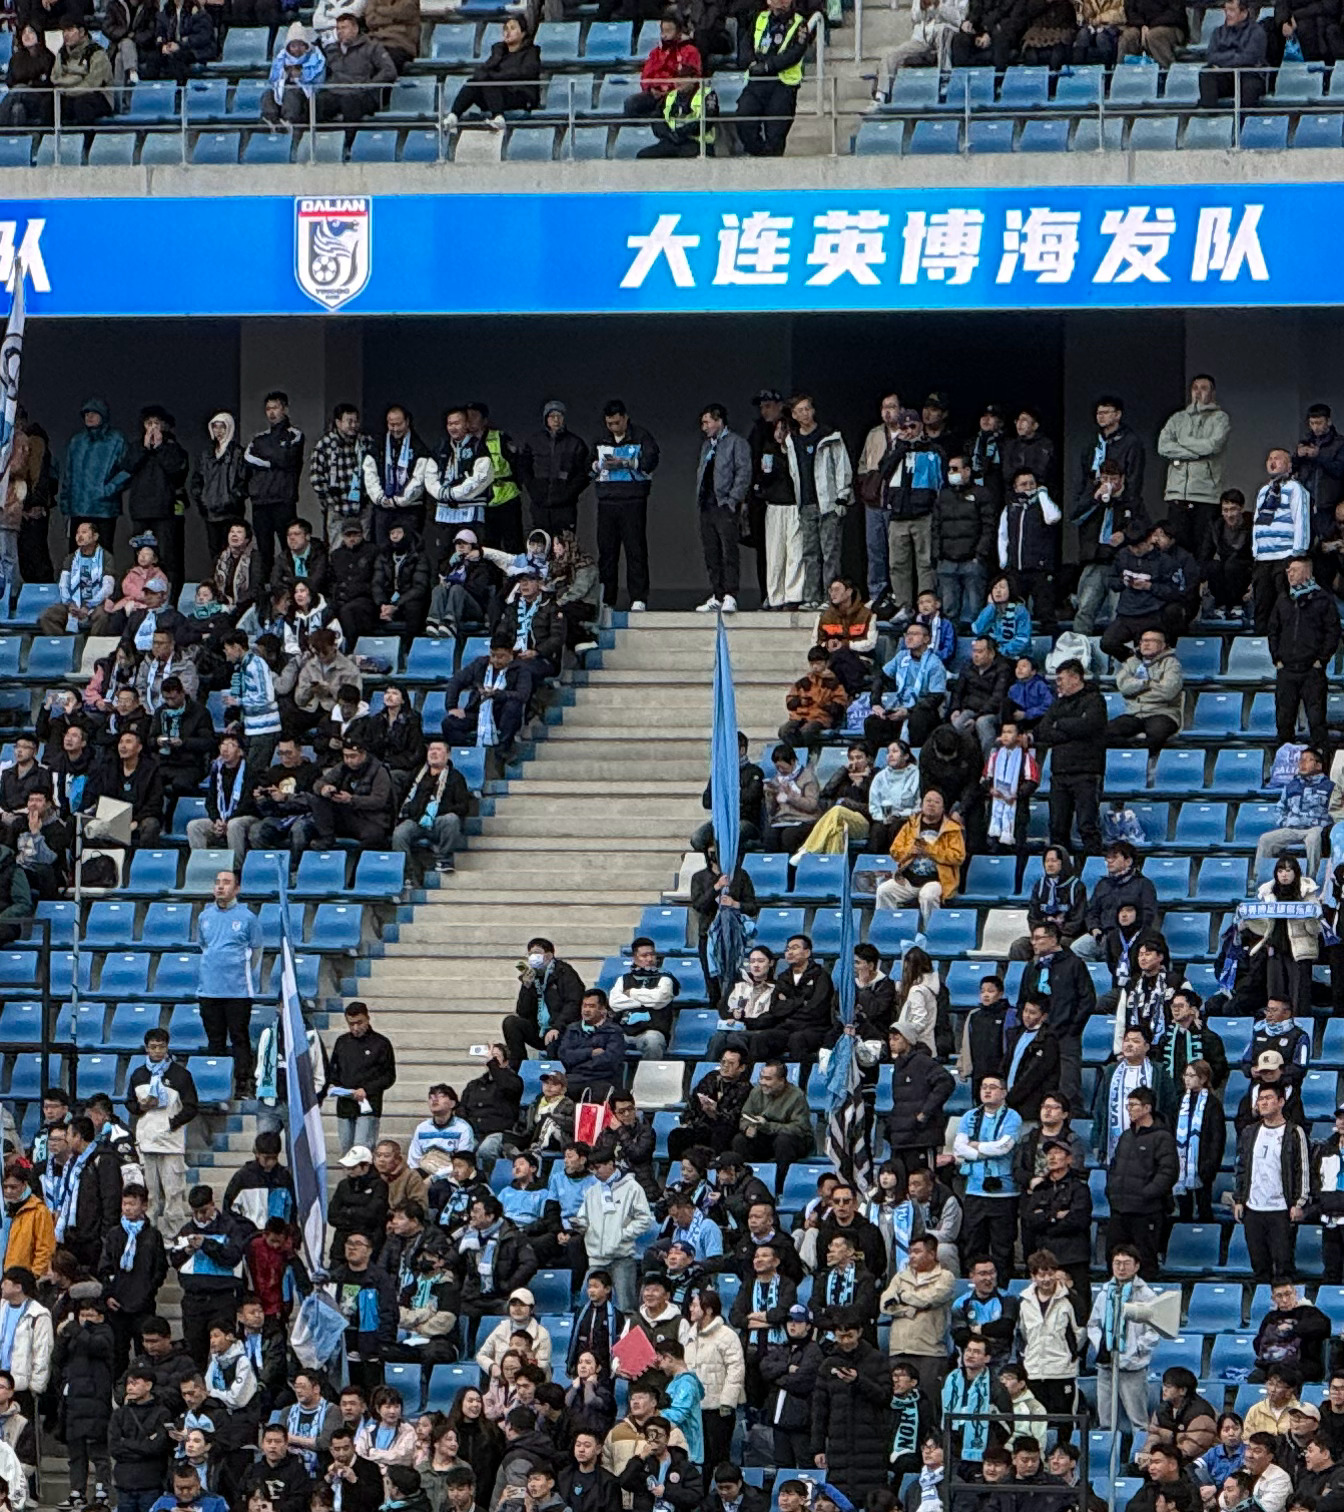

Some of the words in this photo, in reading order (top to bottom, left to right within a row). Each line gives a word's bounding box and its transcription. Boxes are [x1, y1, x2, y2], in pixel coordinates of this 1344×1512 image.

[619, 203, 1271, 288] 大连英博海发队
